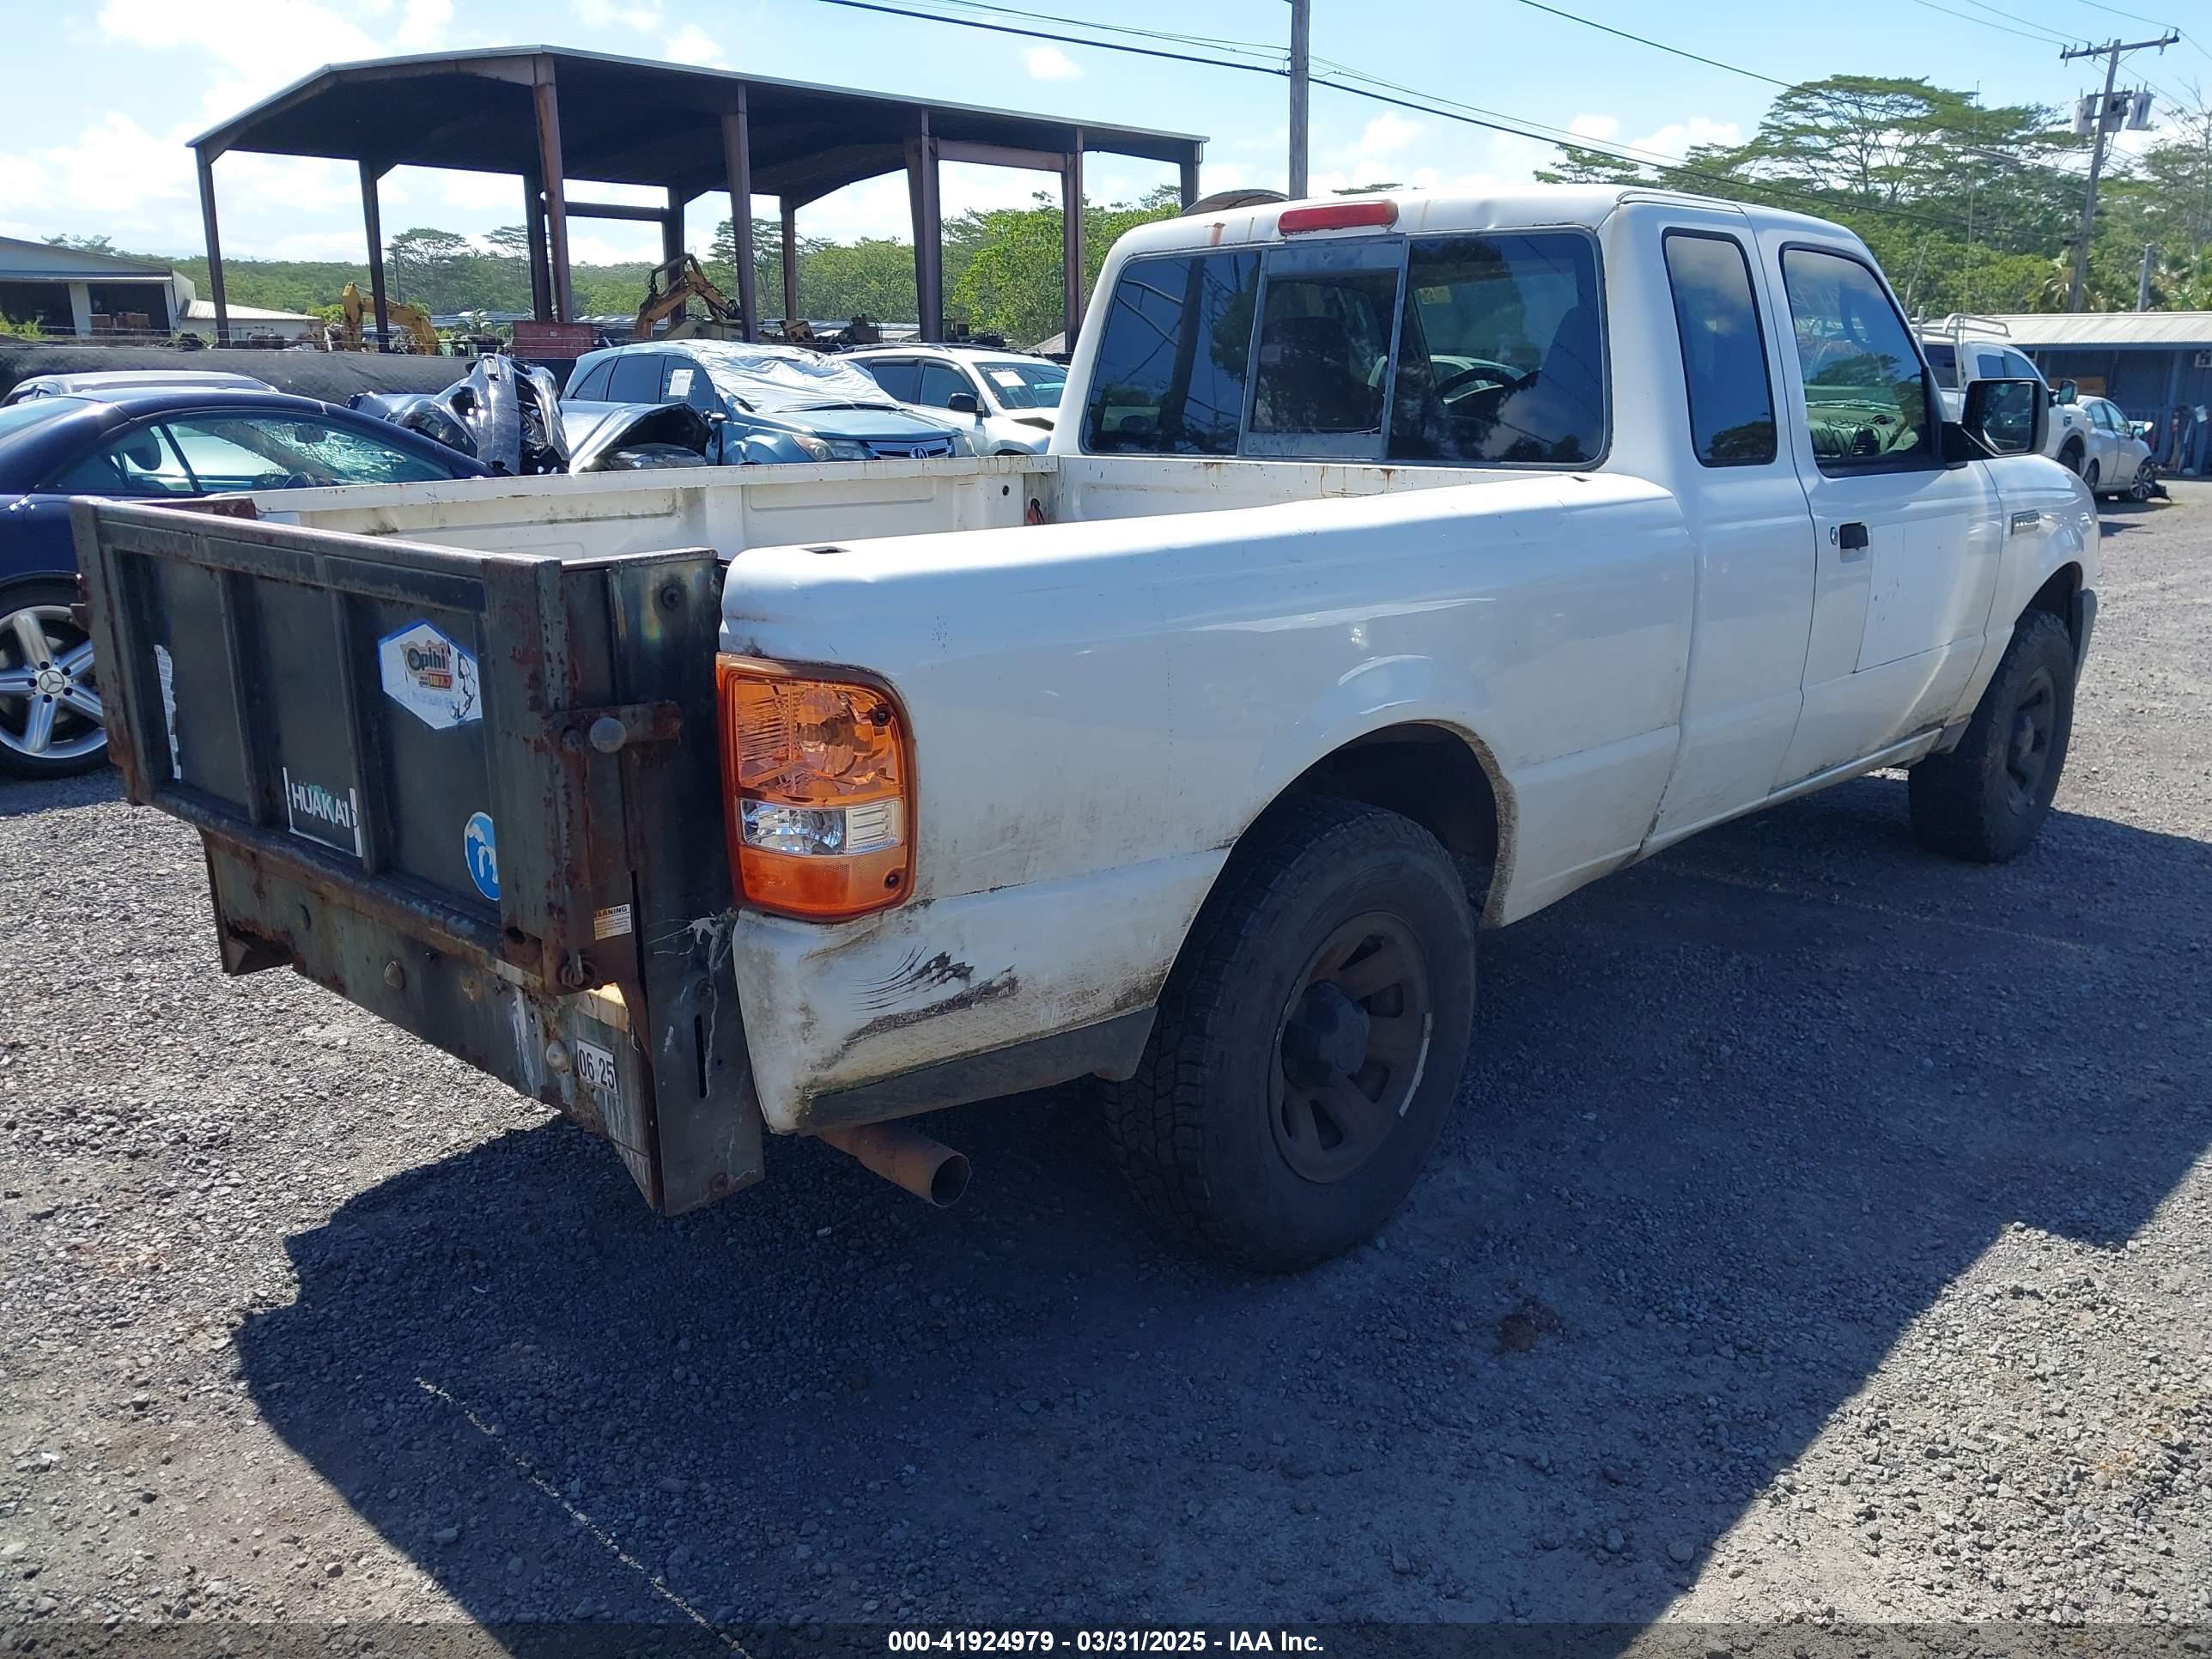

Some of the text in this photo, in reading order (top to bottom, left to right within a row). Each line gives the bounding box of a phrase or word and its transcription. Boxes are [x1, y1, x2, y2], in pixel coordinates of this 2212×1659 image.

[407, 645, 446, 672] Opihi
[579, 1049, 615, 1089] 06 25
